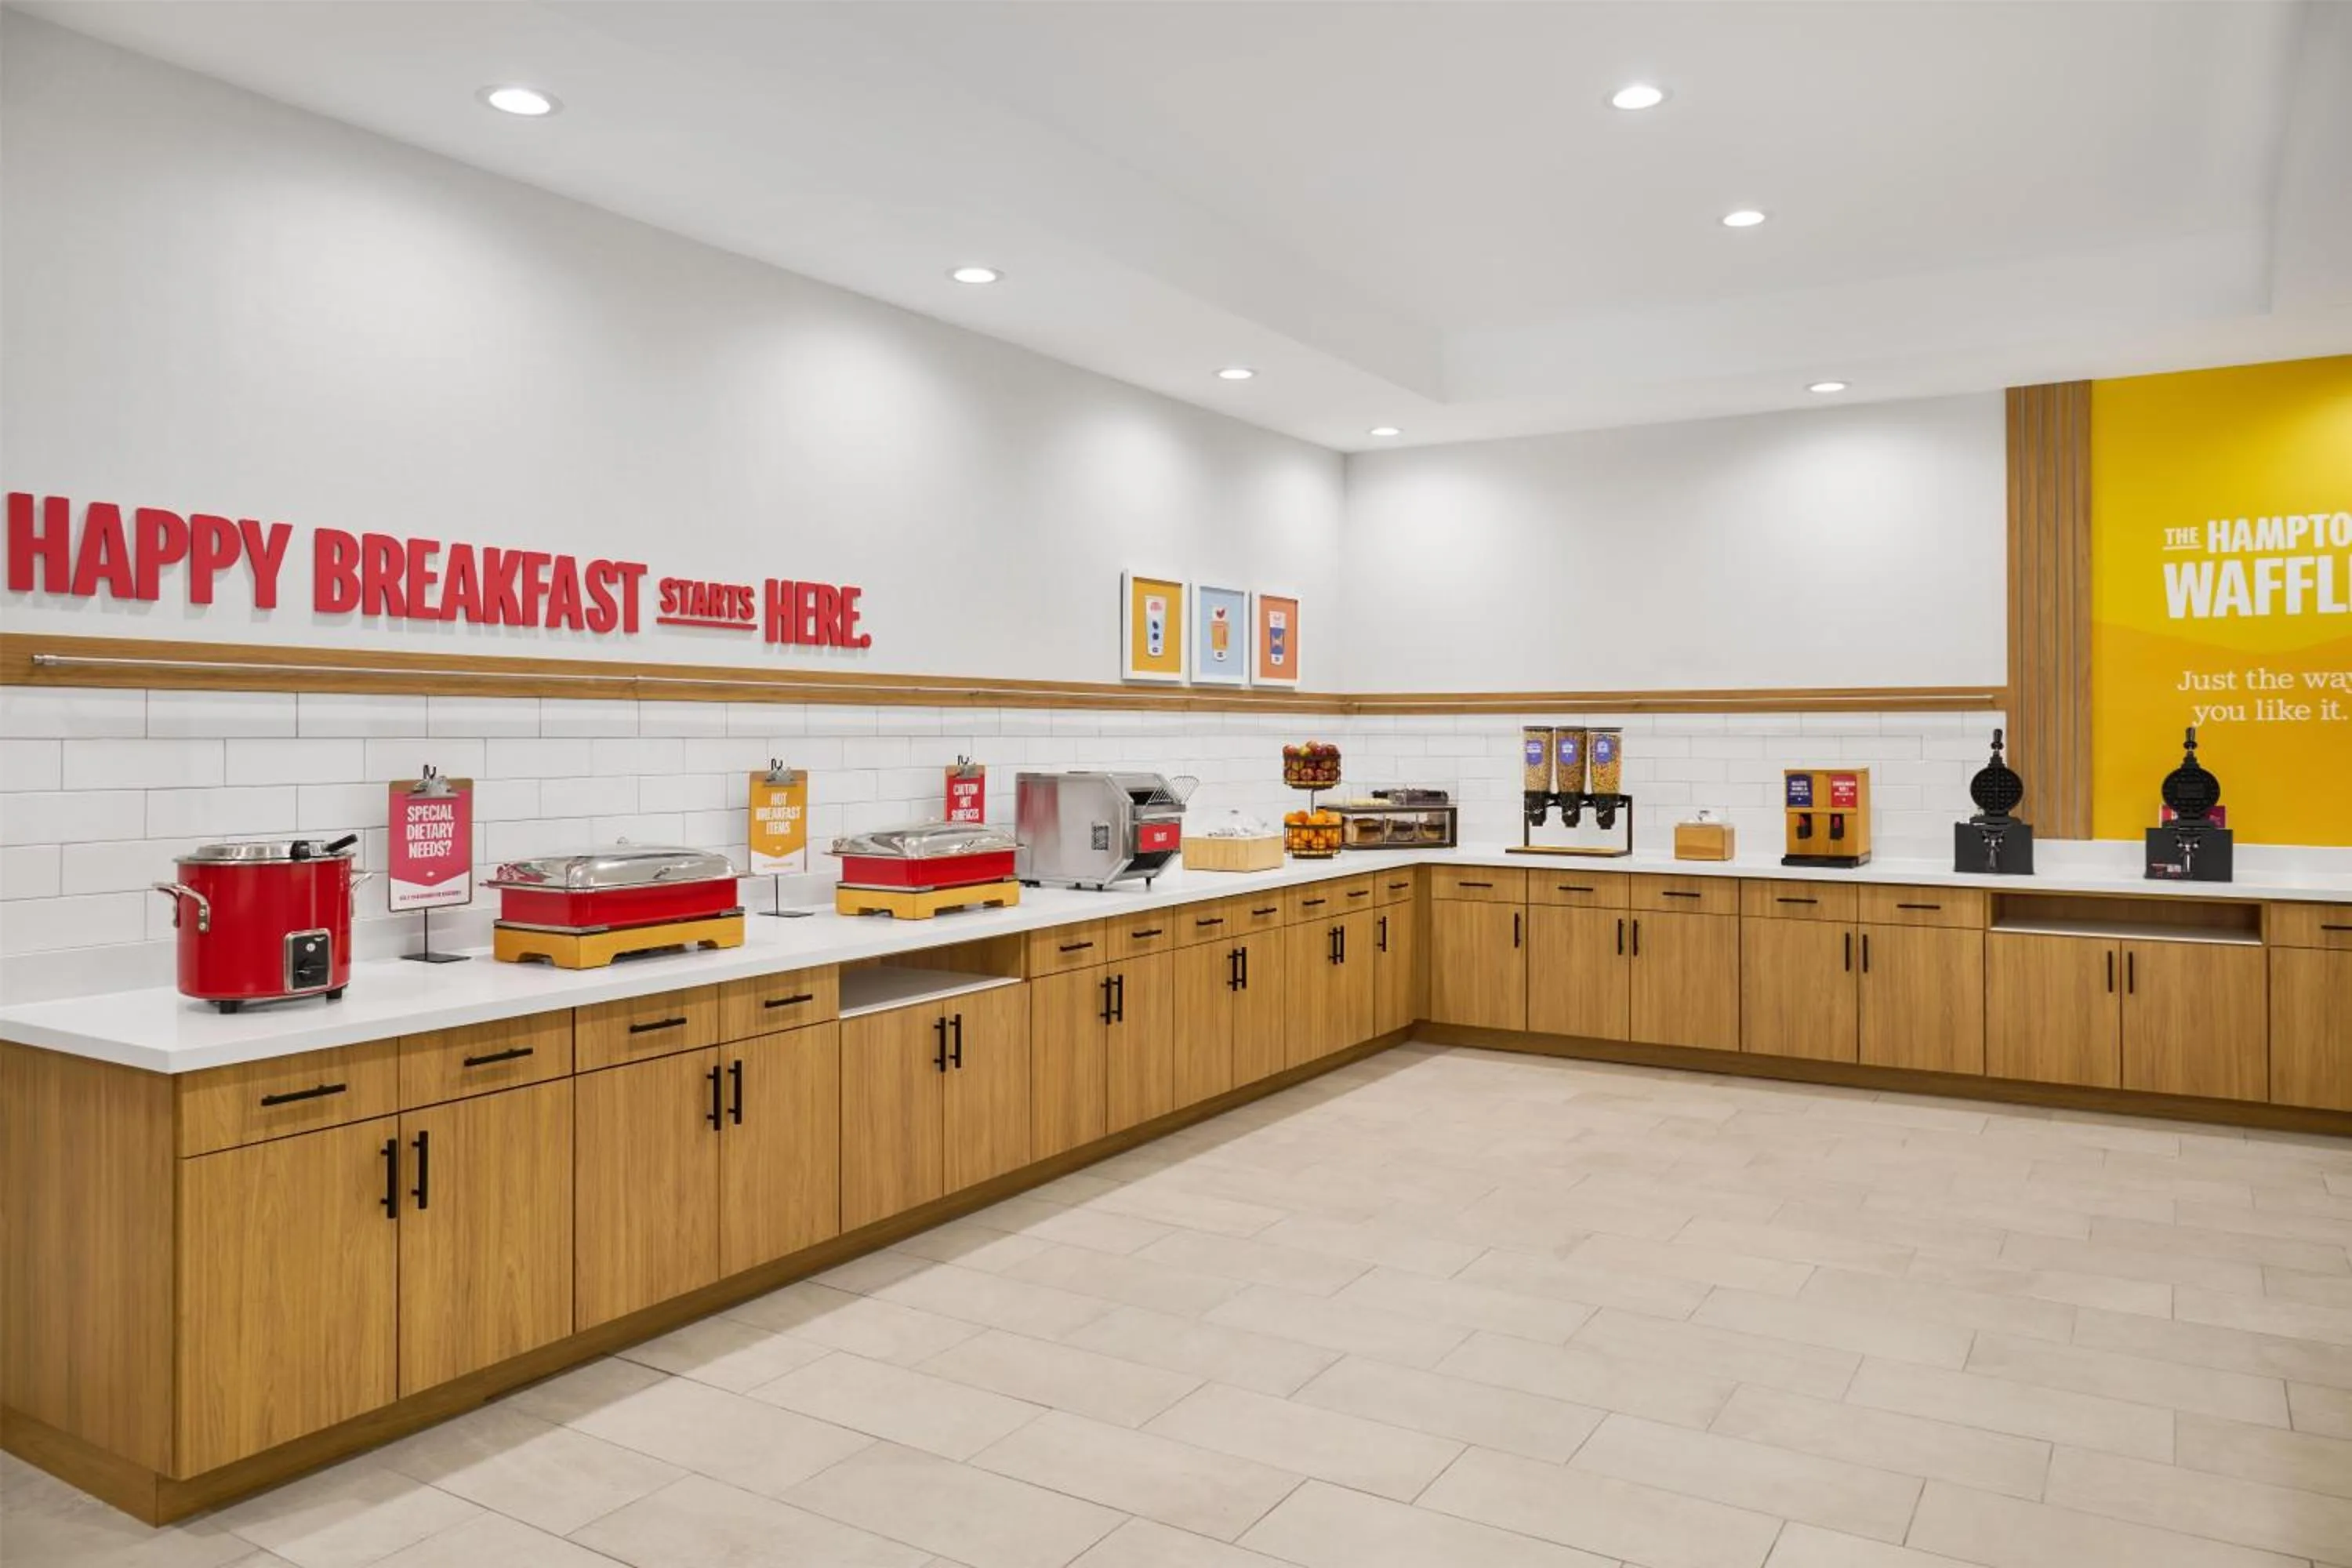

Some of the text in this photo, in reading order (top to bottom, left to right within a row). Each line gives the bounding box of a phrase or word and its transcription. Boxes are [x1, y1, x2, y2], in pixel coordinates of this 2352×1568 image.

[2165, 527, 2199, 545] THE
[8, 492, 872, 648] HAPPY BREAKFAST STARTS HERE.
[2163, 554, 2352, 619] WAFFL
[2176, 670, 2238, 691] Just
[2245, 668, 2294, 690] the
[2192, 698, 2349, 728] you like it.
[771, 793, 787, 807] HOT
[407, 804, 454, 822] SPECIAL
[755, 806, 801, 822] BREAKFAST
[406, 822, 455, 841] DIETARY
[766, 821, 791, 835] ITEMS
[408, 840, 452, 858] NEEDS?
